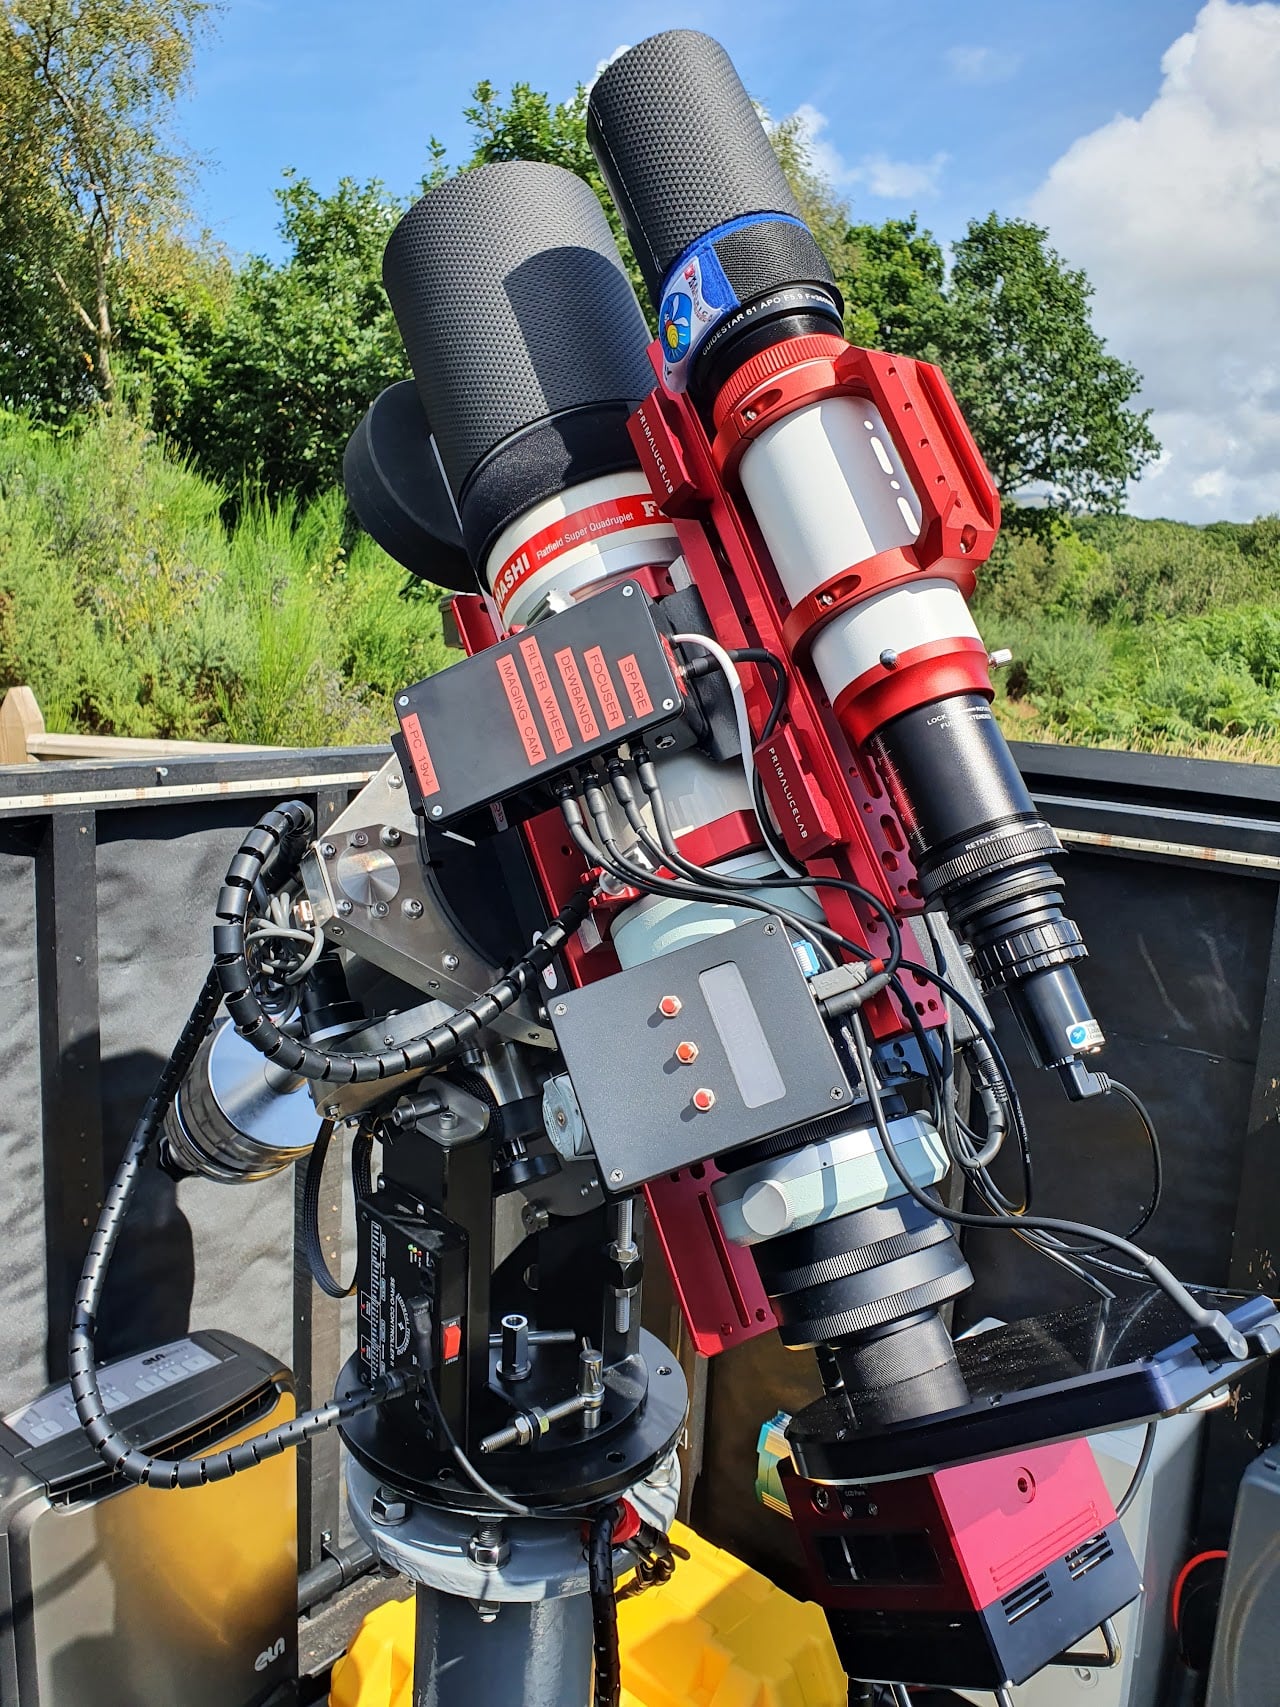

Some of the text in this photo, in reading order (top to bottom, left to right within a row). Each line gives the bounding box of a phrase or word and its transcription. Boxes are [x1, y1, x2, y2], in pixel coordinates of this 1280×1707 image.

[702, 311, 746, 356] GUIDESTAR
[745, 306, 758, 316] 61
[760, 297, 781, 310] APO
[636, 407, 674, 494] PRIMALUCELAB
[536, 536, 564, 560] Flatfield
[564, 526, 588, 544] Super
[589, 512, 635, 533] Quadruplet
[501, 661, 541, 758] IMAGING CAM
[525, 642, 563, 747] FILTER WHEEL
[560, 654, 594, 735] DEWBANDS
[589, 653, 619, 723] FOCUSER
[623, 661, 648, 710] SPARE
[926, 713, 947, 726] LOCK
[409, 729, 422, 749] PC
[768, 746, 808, 839] PRIMALUCELAB
